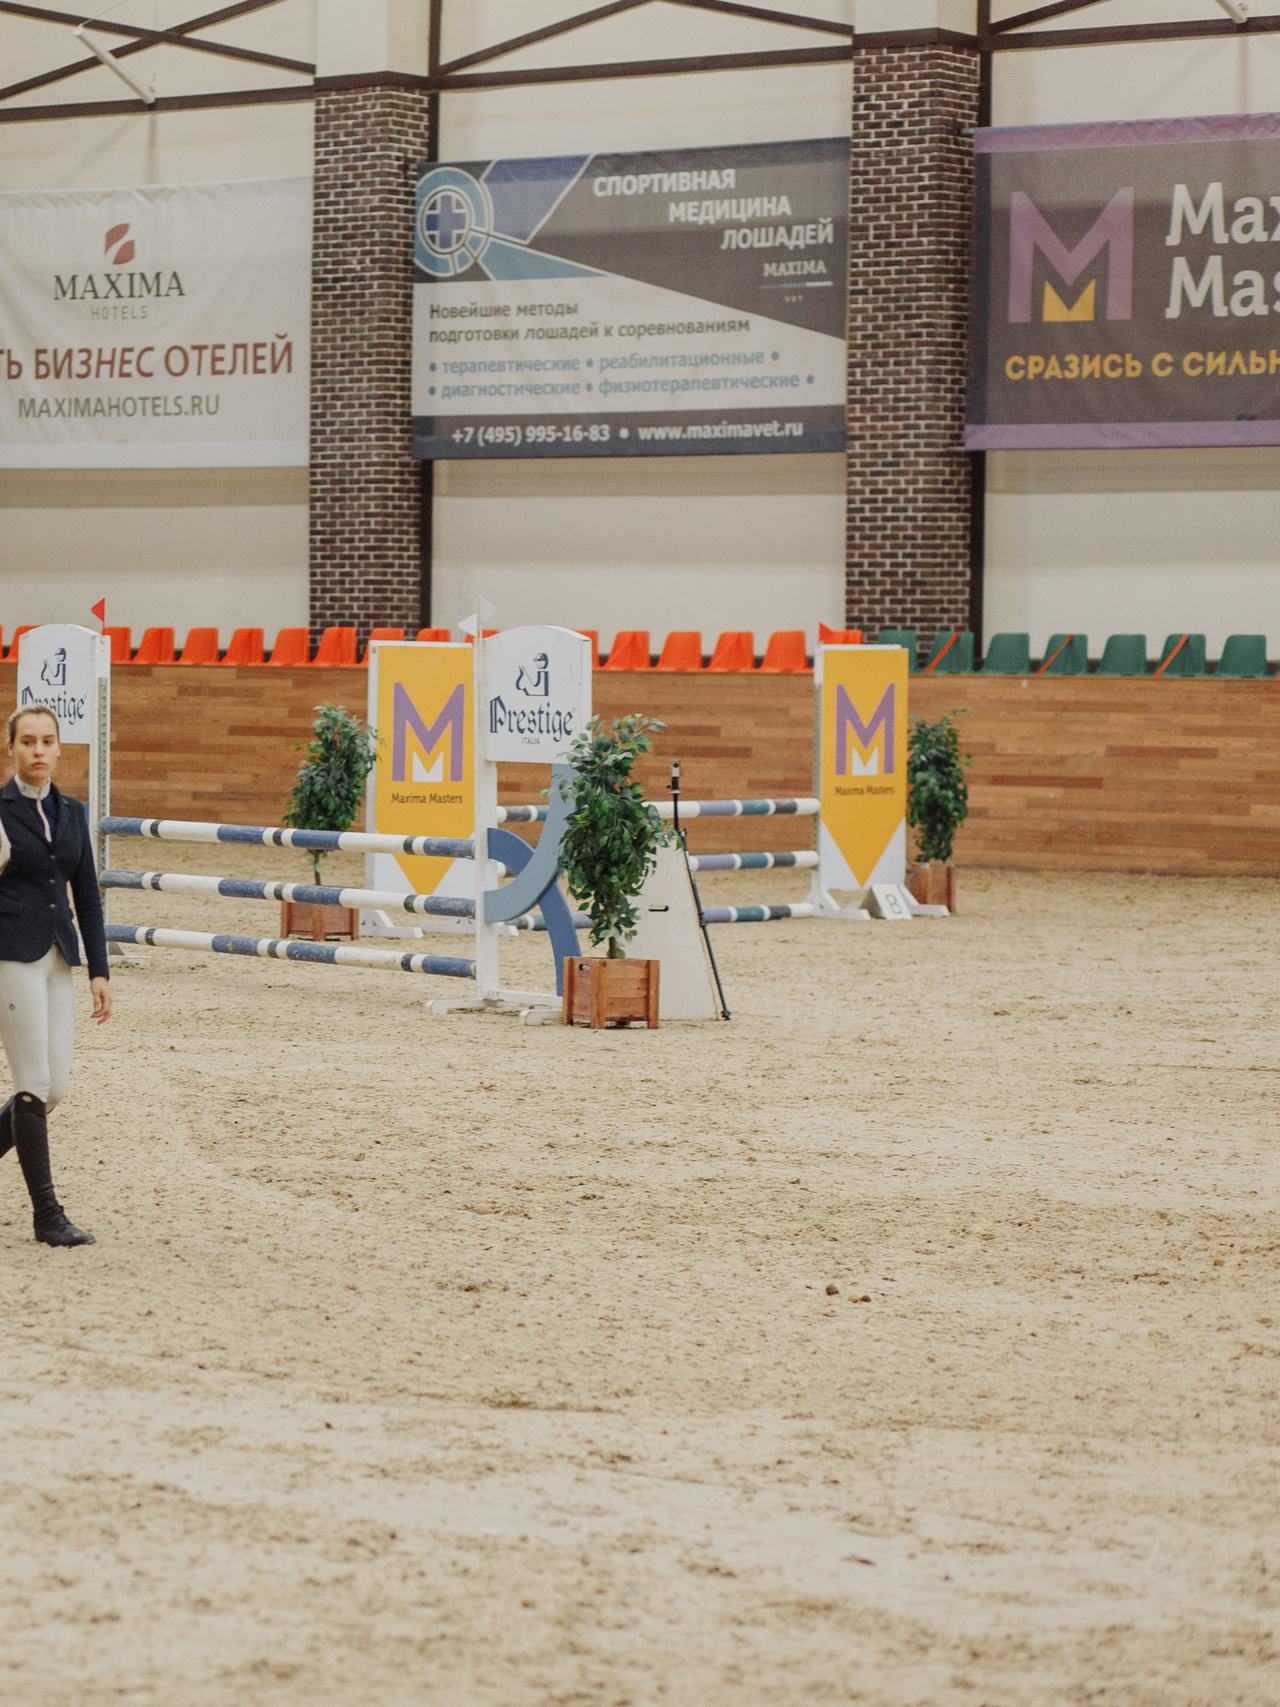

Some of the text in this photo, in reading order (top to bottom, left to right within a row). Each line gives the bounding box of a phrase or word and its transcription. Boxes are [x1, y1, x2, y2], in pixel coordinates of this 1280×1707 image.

[593, 168, 736, 198] СПОРТИВНАЯ
[669, 195, 792, 225] МЕДИЦИНА
[721, 217, 834, 251] ЛОШАДЕЙ
[763, 259, 828, 277] MAXIMA
[54, 271, 186, 301] MAXIMA
[1165, 255, 1280, 319] Ma
[91, 306, 149, 321] HOTELS
[429, 302, 579, 319] Новейшие методы
[429, 319, 751, 344] подготовки лошадей к соревнованиям
[35, 346, 155, 380] БИЗНЕС
[164, 334, 293, 378] ОТЕЛЕЙ
[442, 351, 766, 377] терапевтические реабилитационные
[1005, 353, 1143, 381] СРАЗИСЬ
[1151, 352, 1174, 378] С
[441, 374, 801, 399] диагностические физиотерапевтические
[19, 394, 220, 419] MAXIMAHOTELS.RU
[452, 420, 804, 447] +7 (495) 995-16-83 www.maximavet.ru
[489, 695, 574, 742] Prestige
[391, 793, 463, 804] Maxima Masters
[885, 894, 902, 914] B
